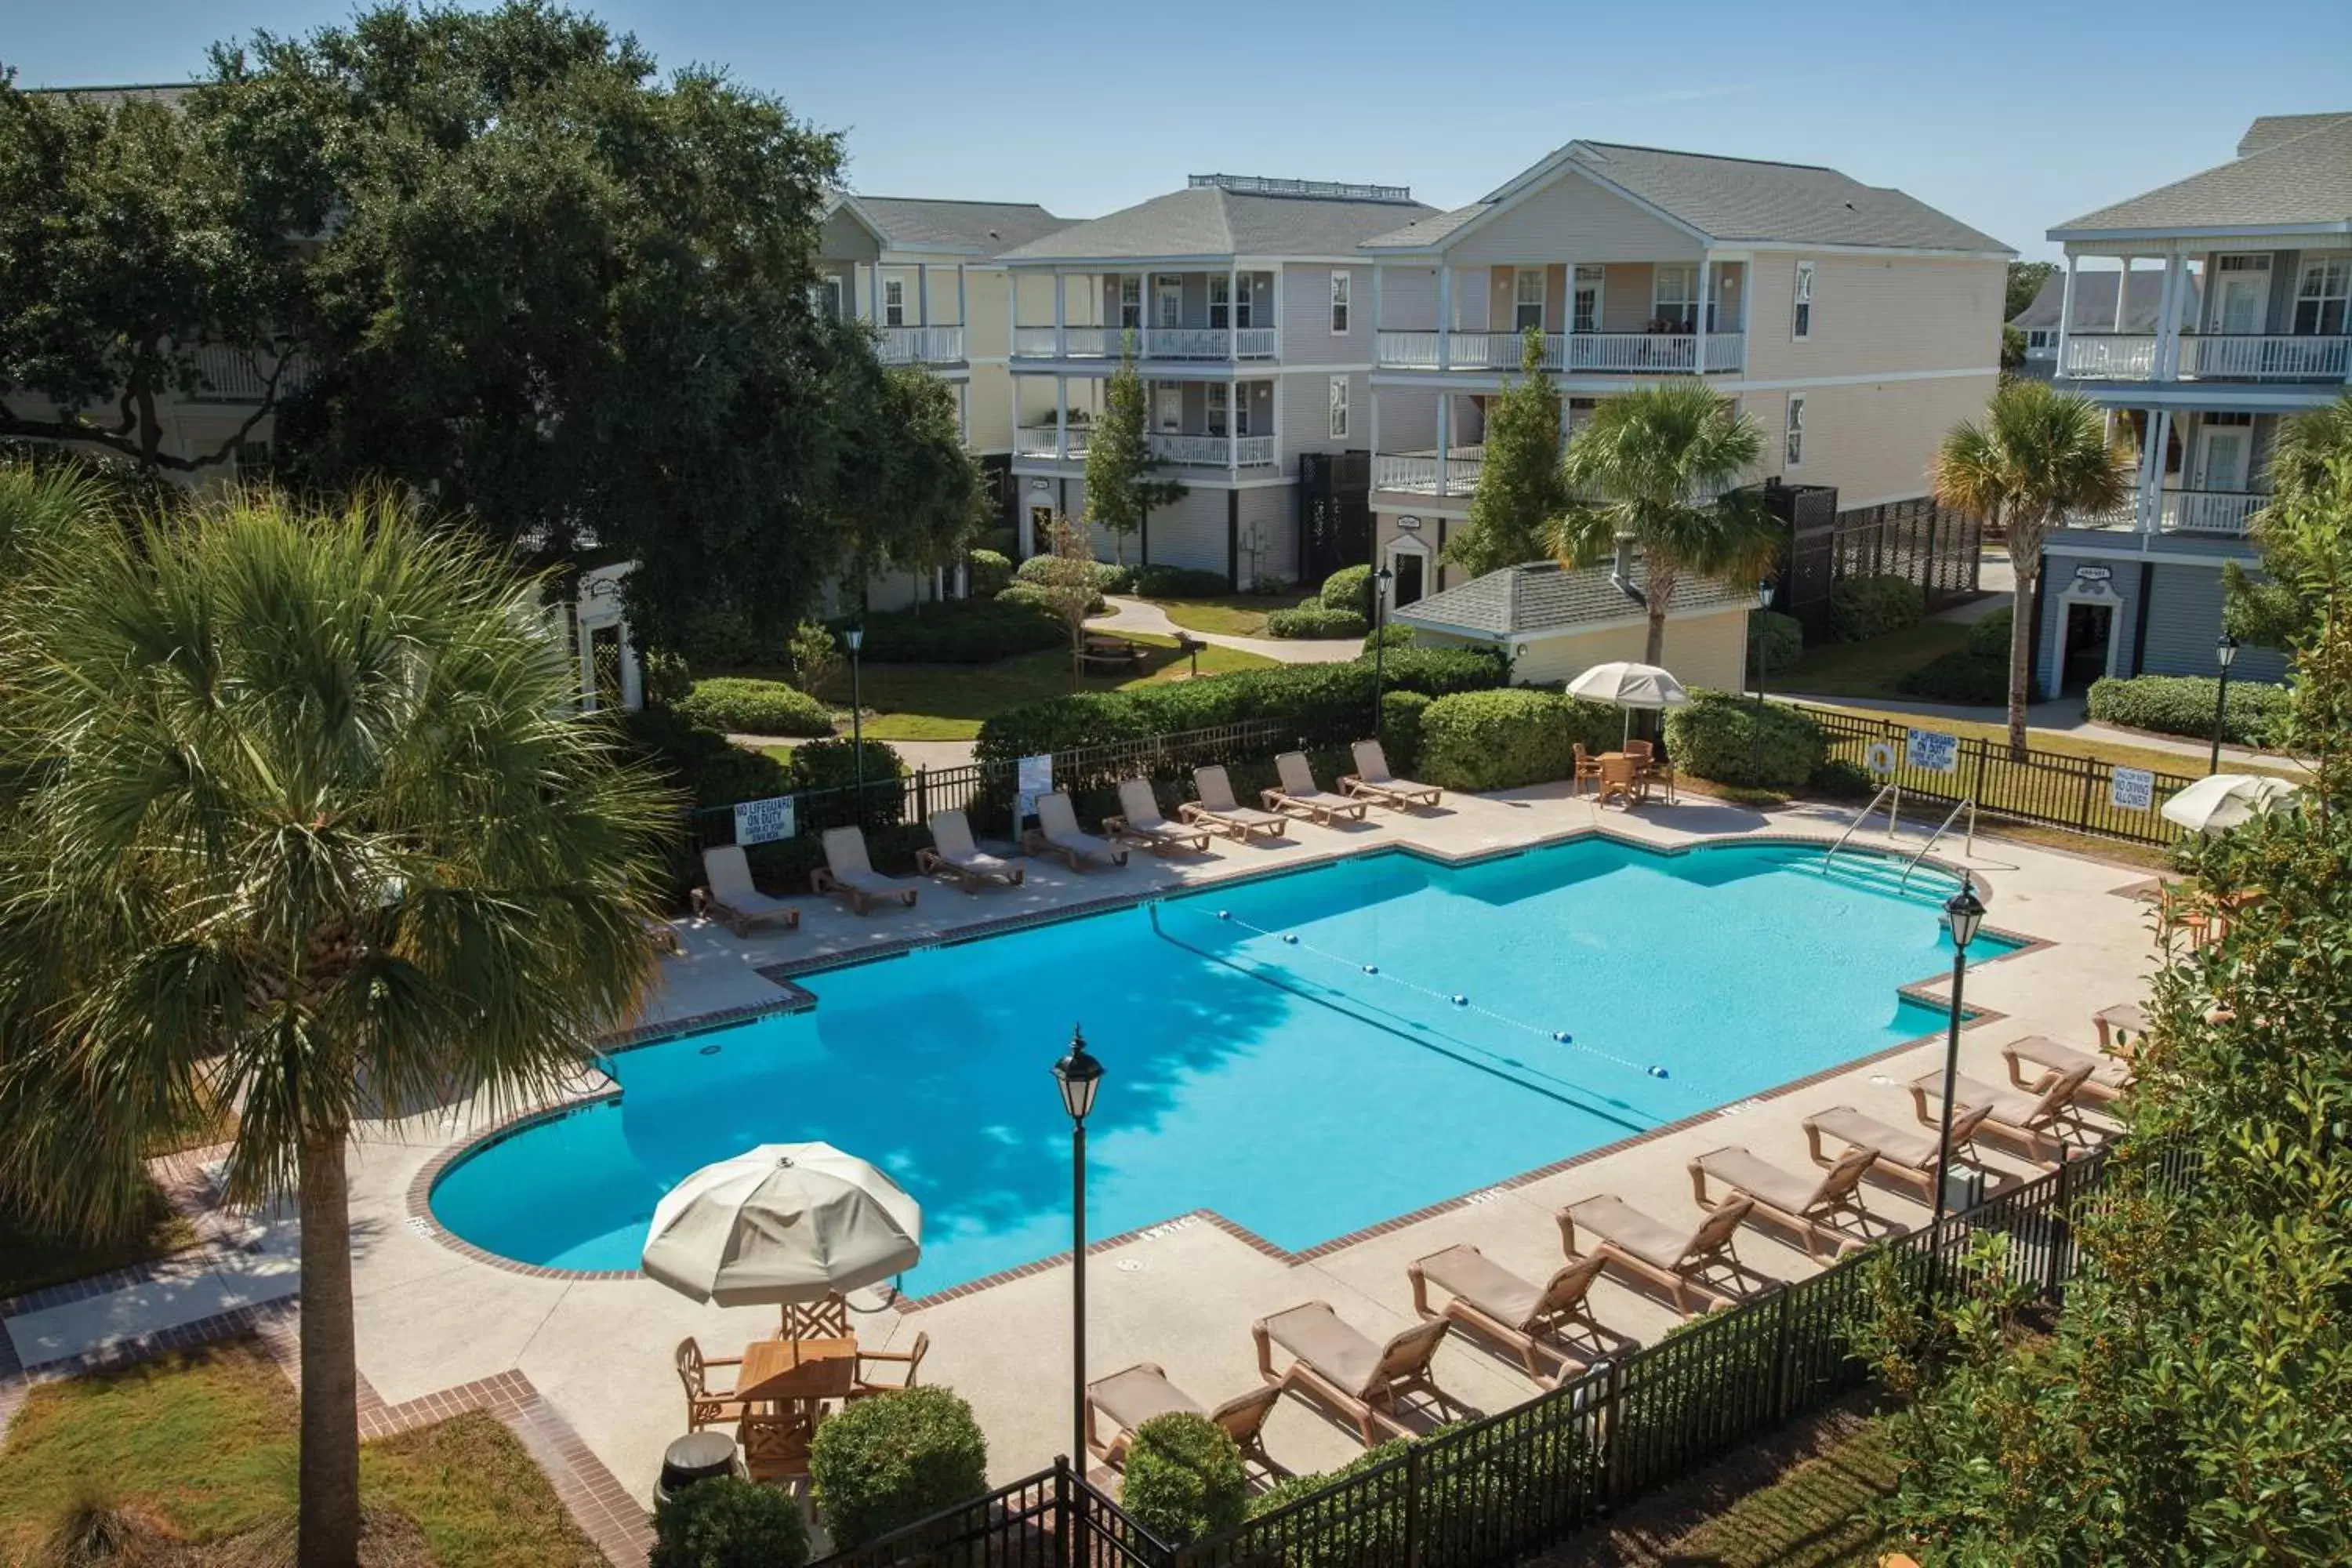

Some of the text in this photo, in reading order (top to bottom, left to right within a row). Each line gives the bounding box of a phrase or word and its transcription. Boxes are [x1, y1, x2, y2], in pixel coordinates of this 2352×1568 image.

[1910, 730, 1956, 747] NO LIFEGUARD
[1918, 740, 1946, 755] ON DUTY
[2116, 779, 2149, 795] NO DIVING
[737, 797, 793, 816] NO LIFEGUARD
[2115, 792, 2147, 806] ALLOWED
[747, 811, 781, 826] ON DUTY
